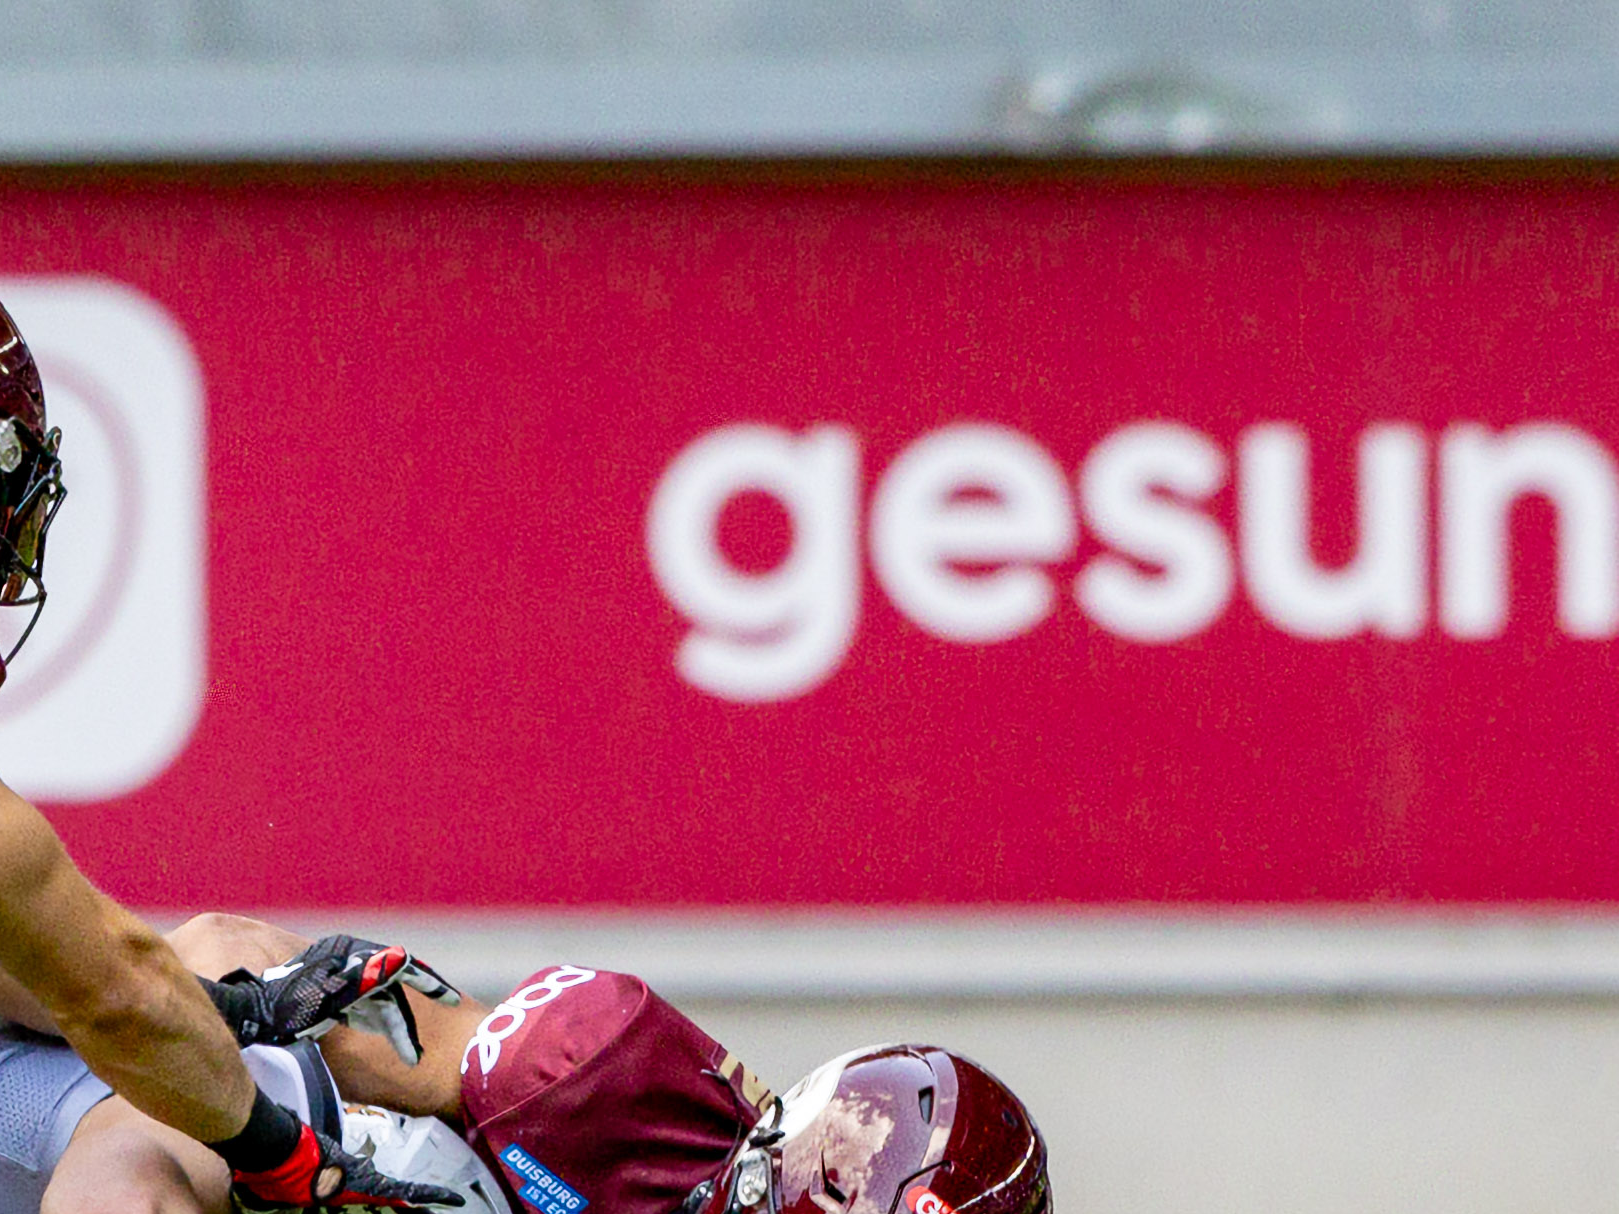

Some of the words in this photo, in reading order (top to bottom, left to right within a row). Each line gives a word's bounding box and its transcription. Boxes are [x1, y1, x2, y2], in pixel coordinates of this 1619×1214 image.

[644, 420, 1619, 703] gesun
[506, 1148, 580, 1209] DUISBURG
[526, 1185, 549, 1205] IST
